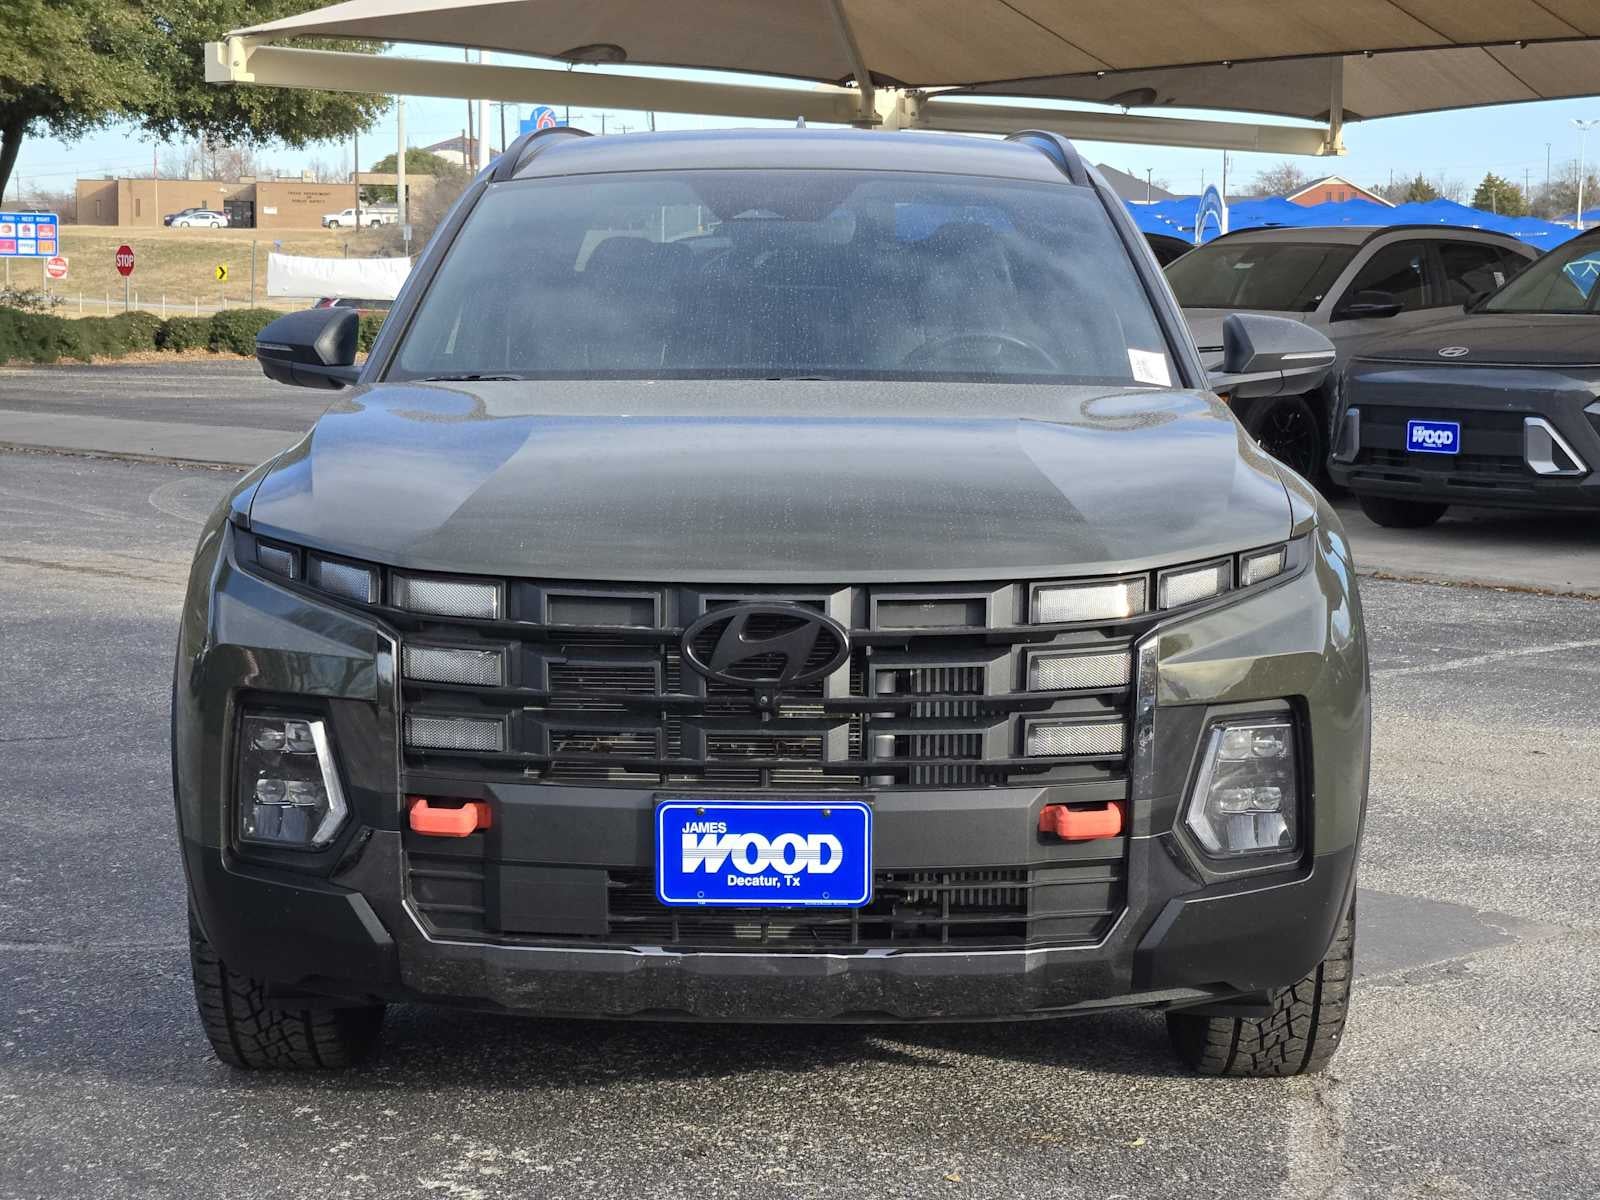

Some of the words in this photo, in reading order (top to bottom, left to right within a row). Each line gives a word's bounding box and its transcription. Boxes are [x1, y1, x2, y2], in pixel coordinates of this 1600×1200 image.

[116, 254, 134, 268] STOP
[1412, 428, 1453, 444] WOOD
[682, 822, 727, 833] JAMES
[682, 833, 844, 875] WOOD
[727, 875, 781, 888] Decatur,
[783, 875, 801, 887] Tx
